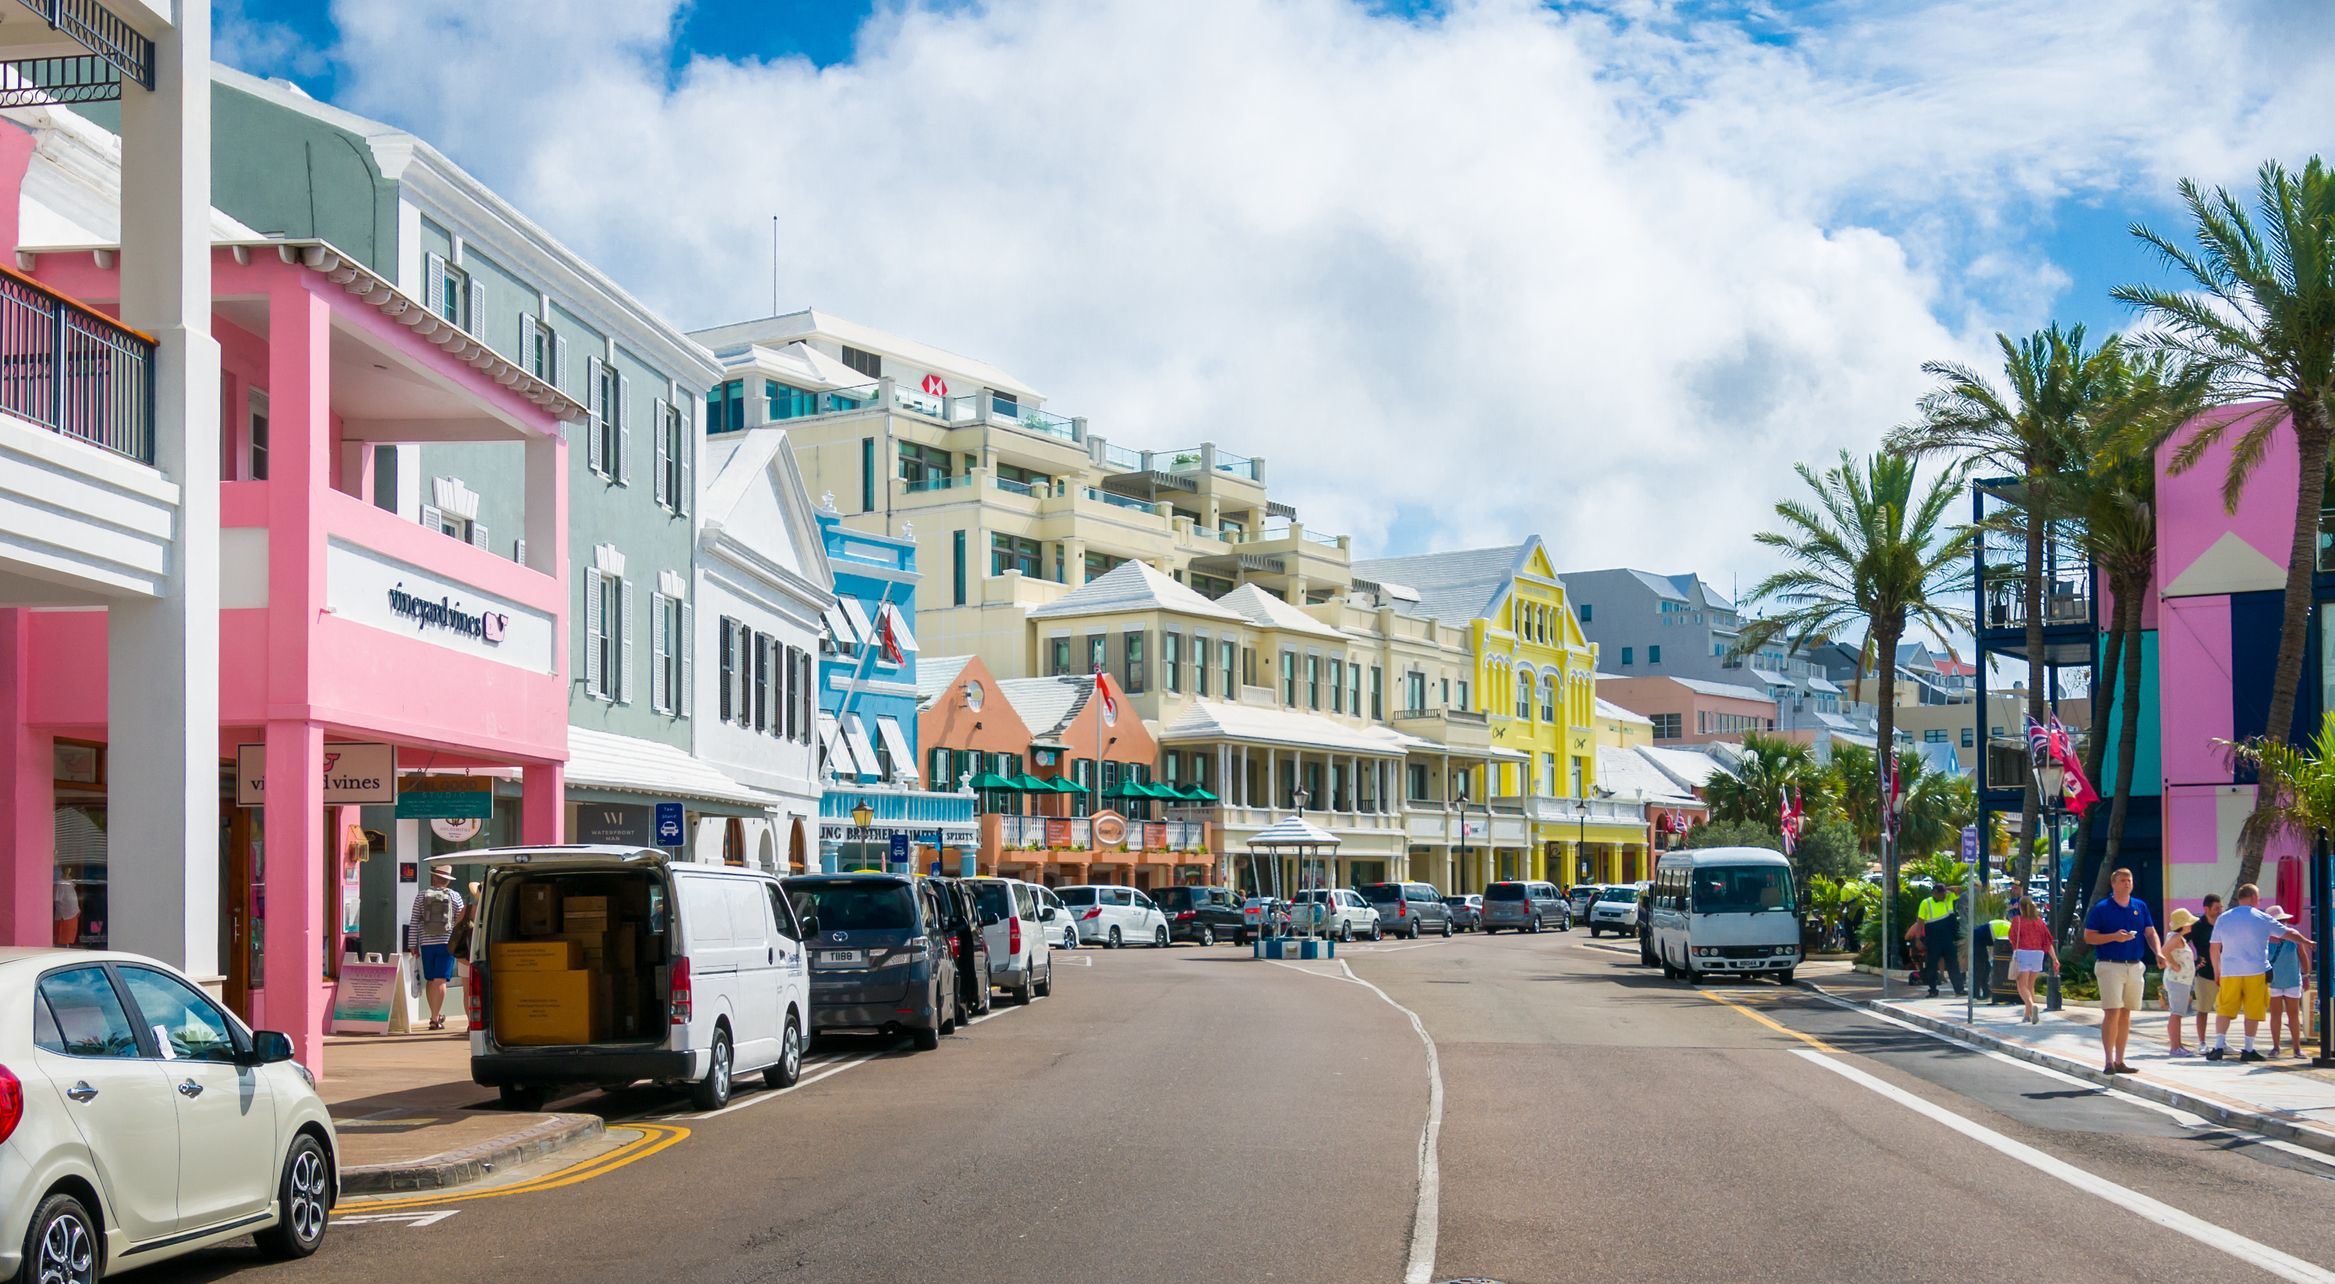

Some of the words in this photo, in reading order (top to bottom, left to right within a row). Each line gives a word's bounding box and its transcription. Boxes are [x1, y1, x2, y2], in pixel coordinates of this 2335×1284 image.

[389, 582, 448, 630] vineyard
[448, 601, 481, 637] vines
[333, 774, 380, 789] vines
[946, 832, 974, 841] SPIRITS
[830, 951, 853, 961] T1188
